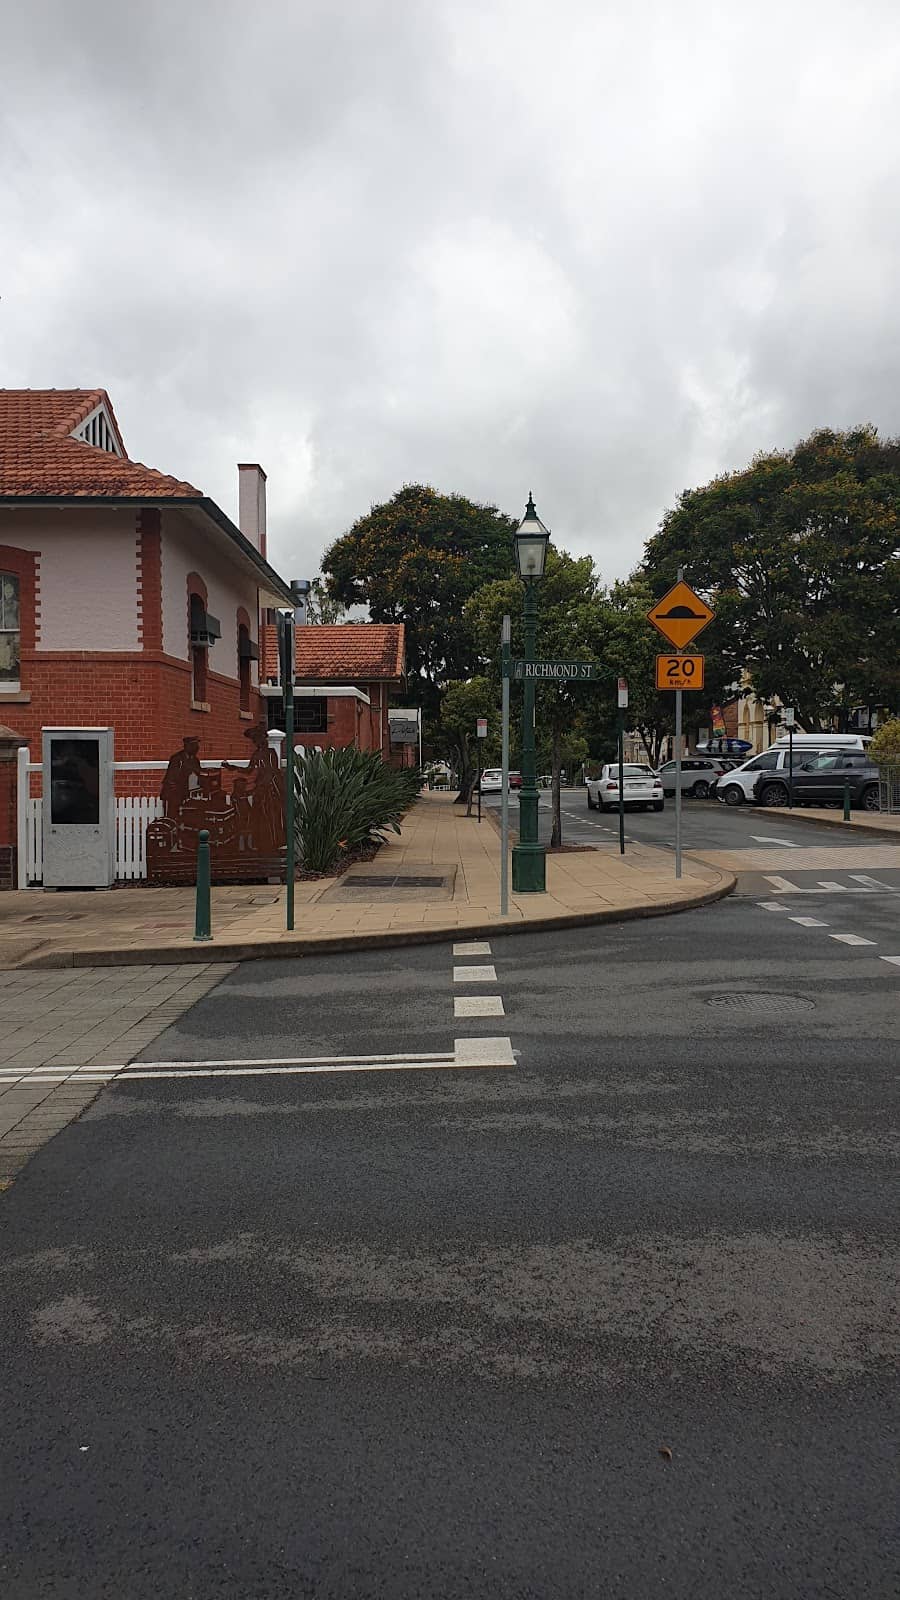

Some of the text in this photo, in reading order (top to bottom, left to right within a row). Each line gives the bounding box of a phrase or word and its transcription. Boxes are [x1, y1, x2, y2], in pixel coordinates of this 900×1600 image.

[525, 663, 593, 678] RICHMOND ST
[666, 659, 695, 677] 20
